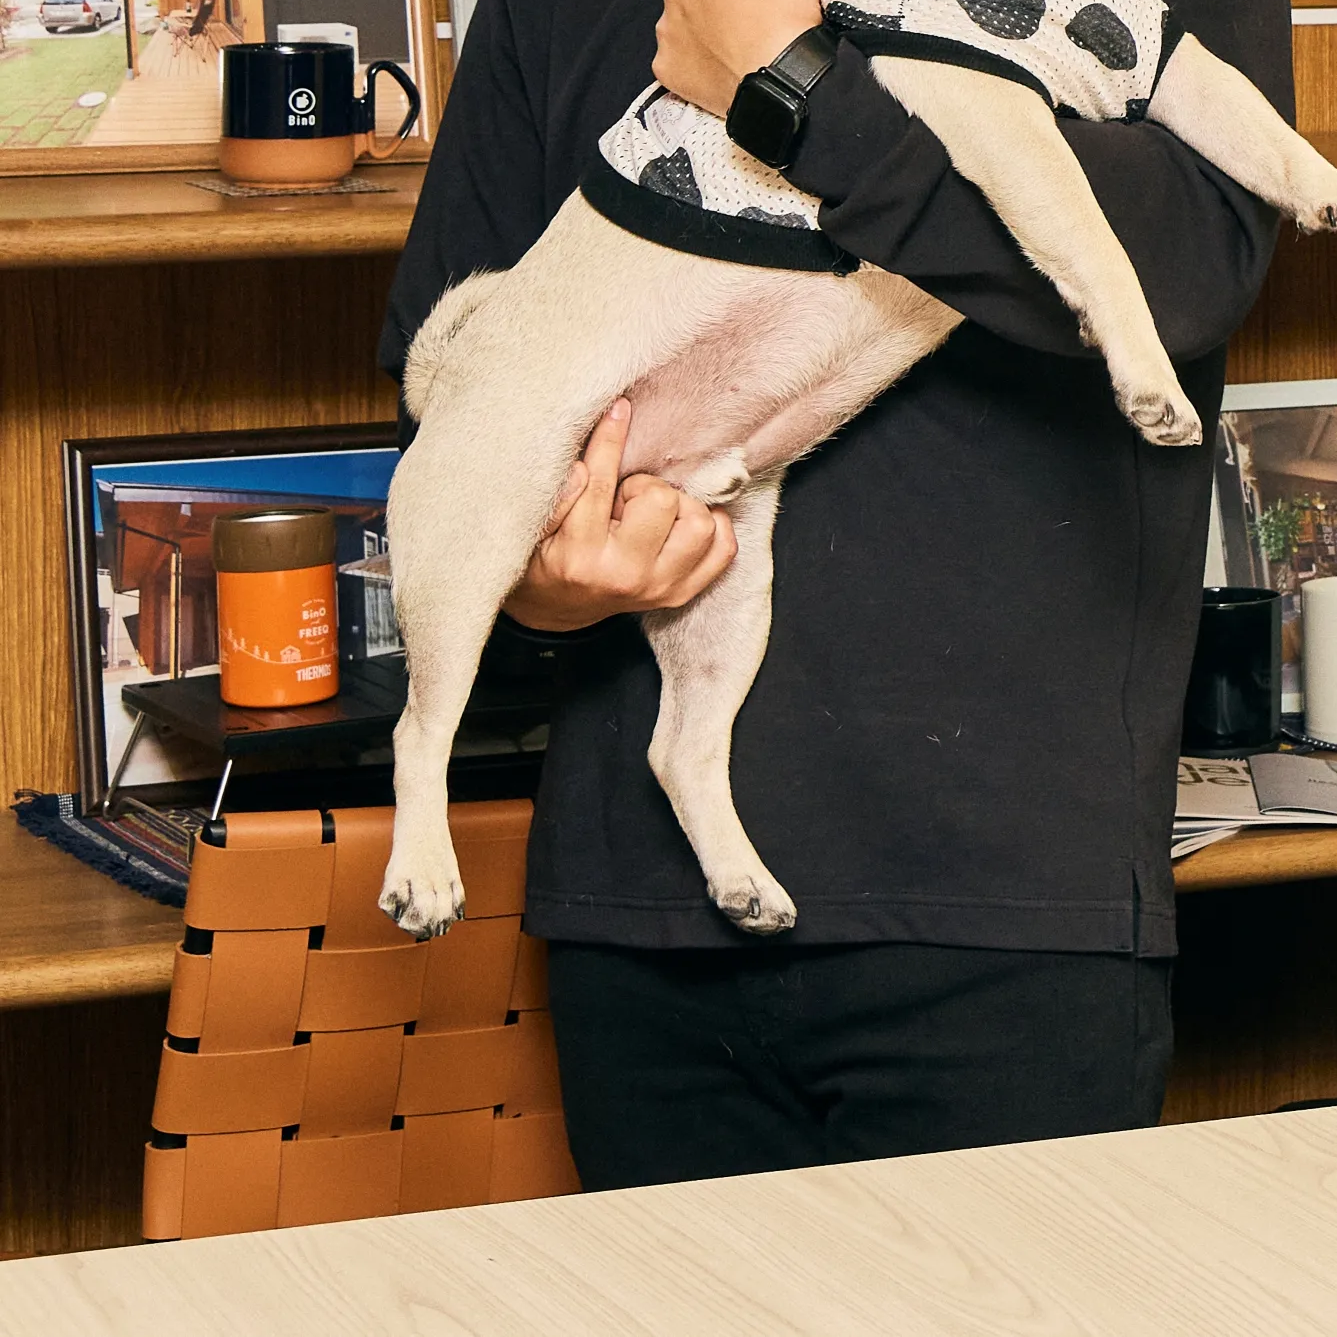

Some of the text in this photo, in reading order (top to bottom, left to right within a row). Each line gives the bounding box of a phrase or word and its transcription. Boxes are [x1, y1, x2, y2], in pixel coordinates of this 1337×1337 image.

[288, 114, 316, 127] BinO
[302, 607, 326, 620] BinO
[295, 663, 332, 682] THERMOS
